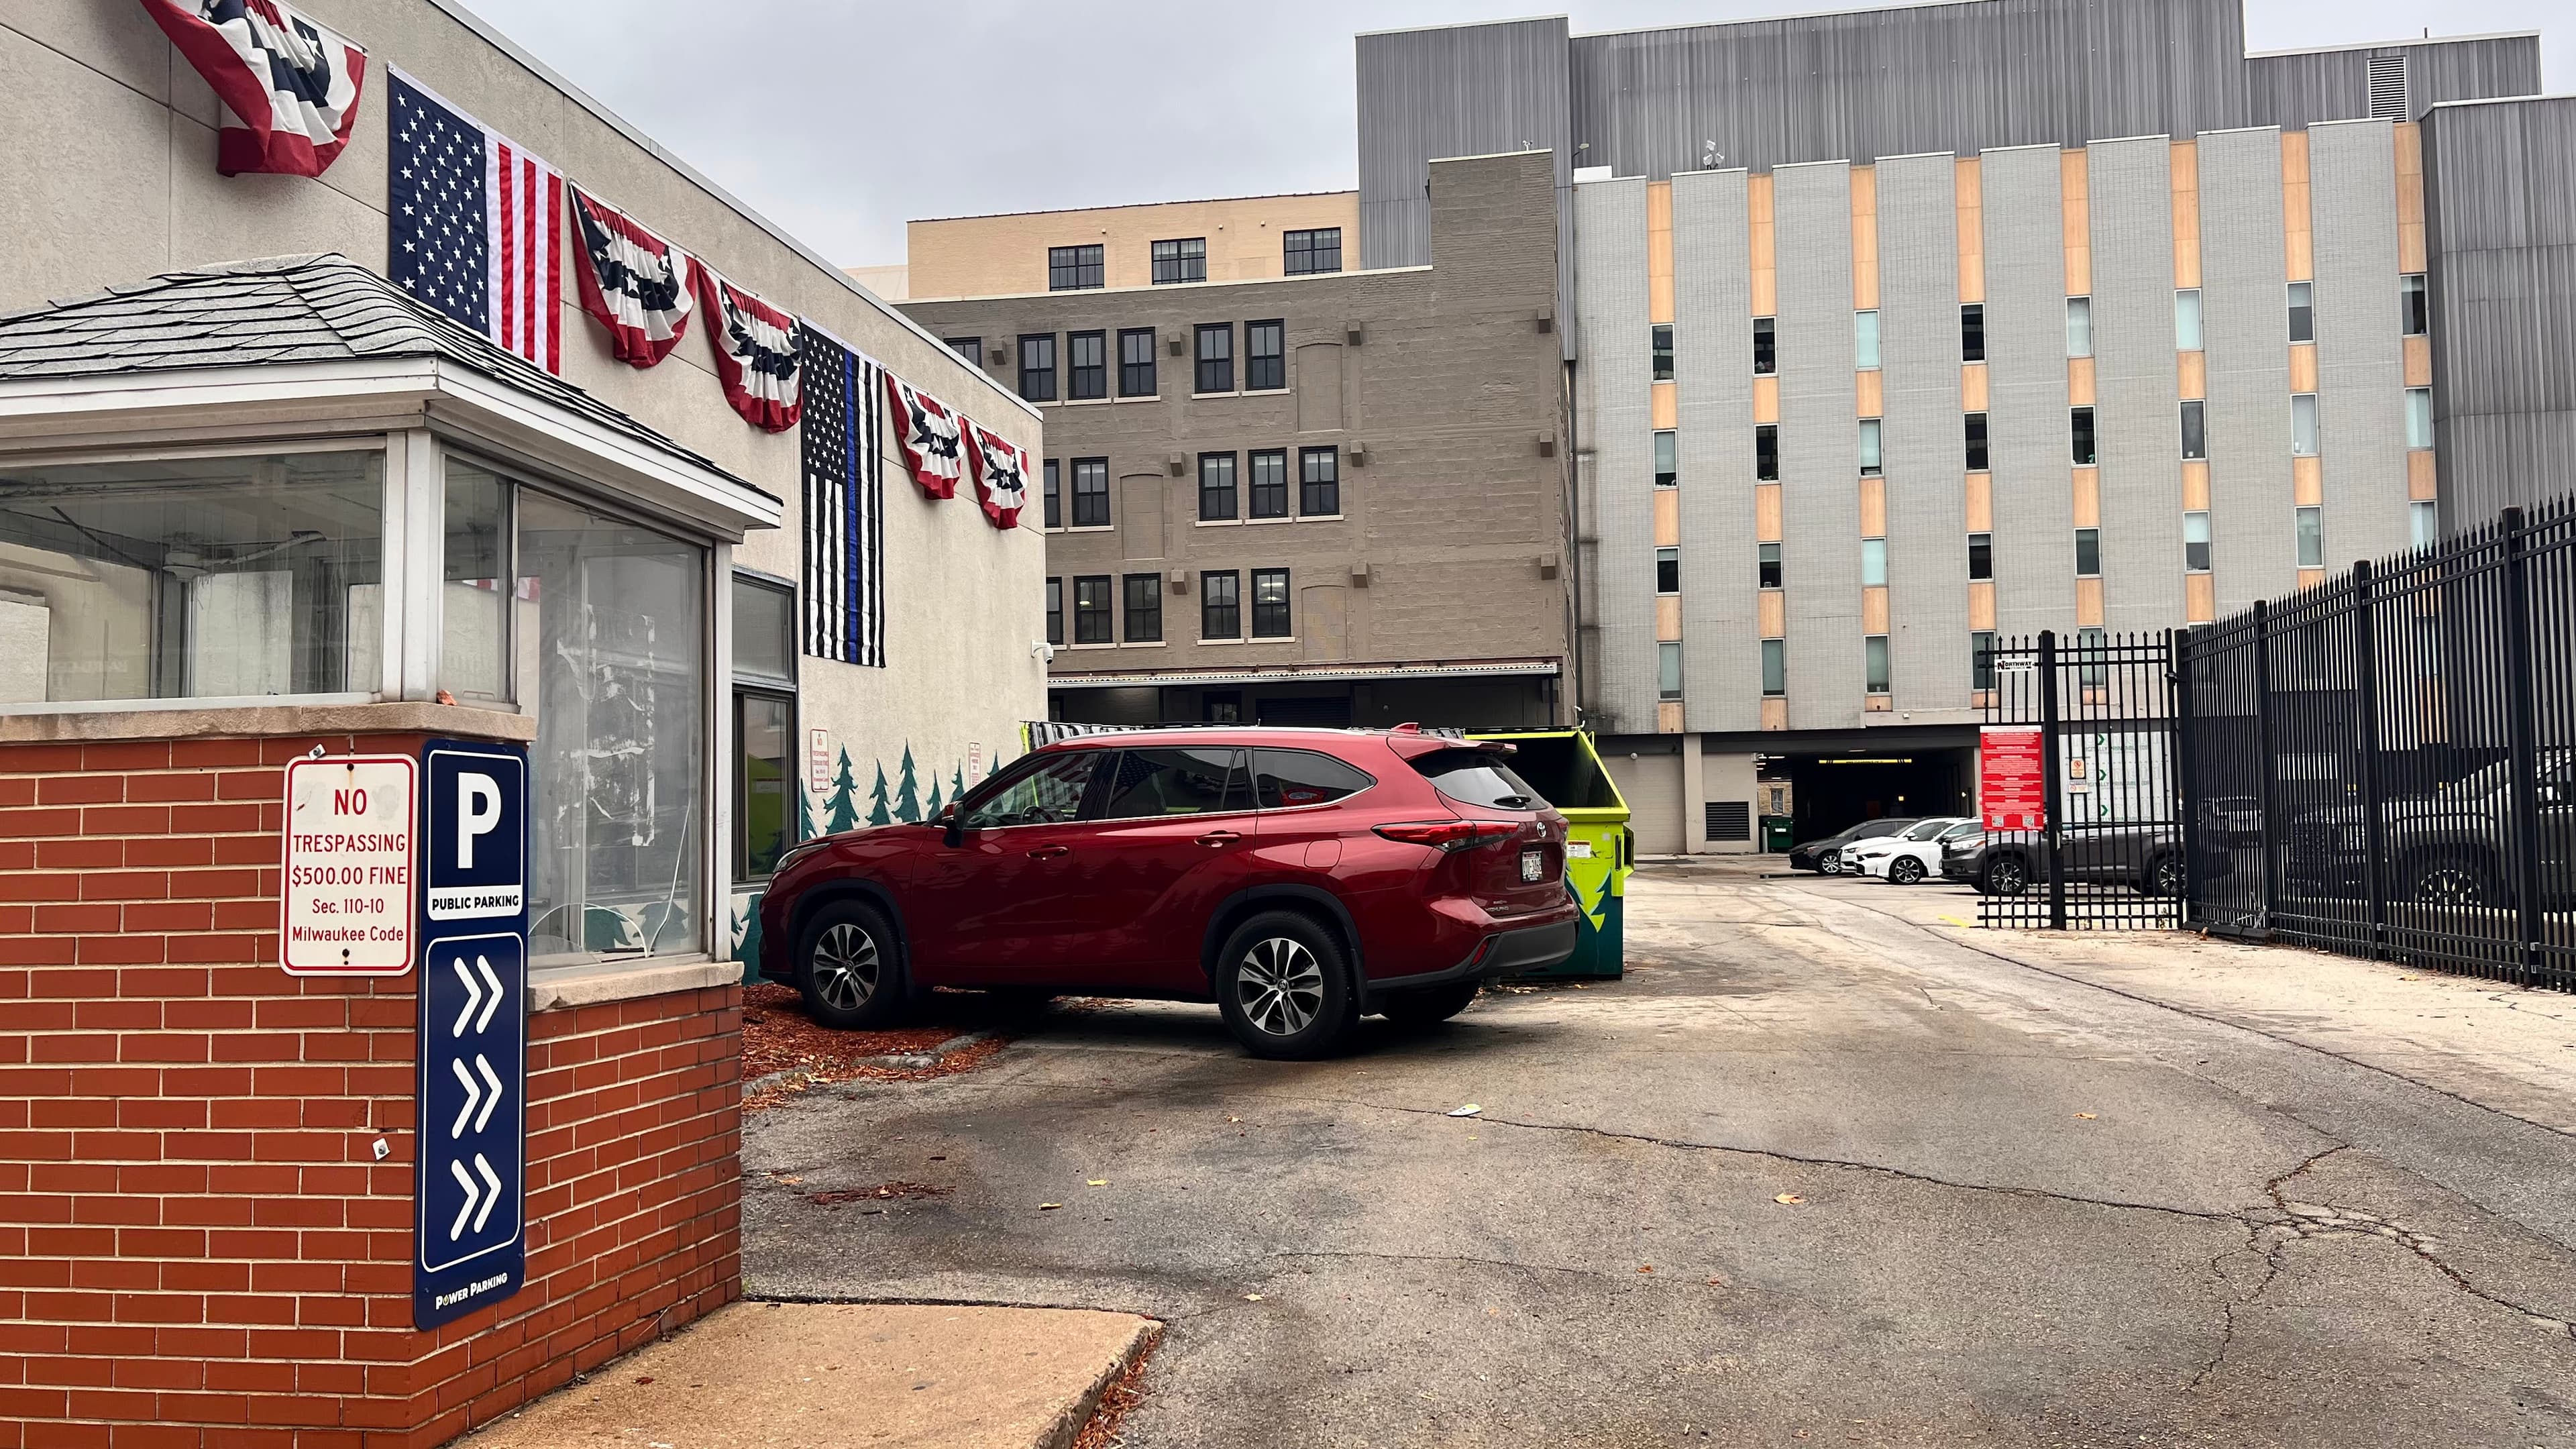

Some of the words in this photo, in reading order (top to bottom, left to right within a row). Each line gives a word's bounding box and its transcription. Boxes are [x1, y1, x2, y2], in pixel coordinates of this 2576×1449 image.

[1997, 660, 2031, 669] NORTHWAY
[334, 789, 367, 815] NO
[458, 771, 502, 869] P
[293, 834, 405, 853] TRESPASSING
[292, 865, 363, 888] $500.00
[370, 866, 407, 885] FINE
[312, 899, 339, 914] Sec.
[344, 898, 384, 913] 110-10
[432, 897, 471, 911] PUBLIC
[474, 895, 519, 908] PARKING
[292, 926, 366, 941] Milwaukee
[370, 926, 404, 941] Code
[470, 1272, 508, 1297] PARKING
